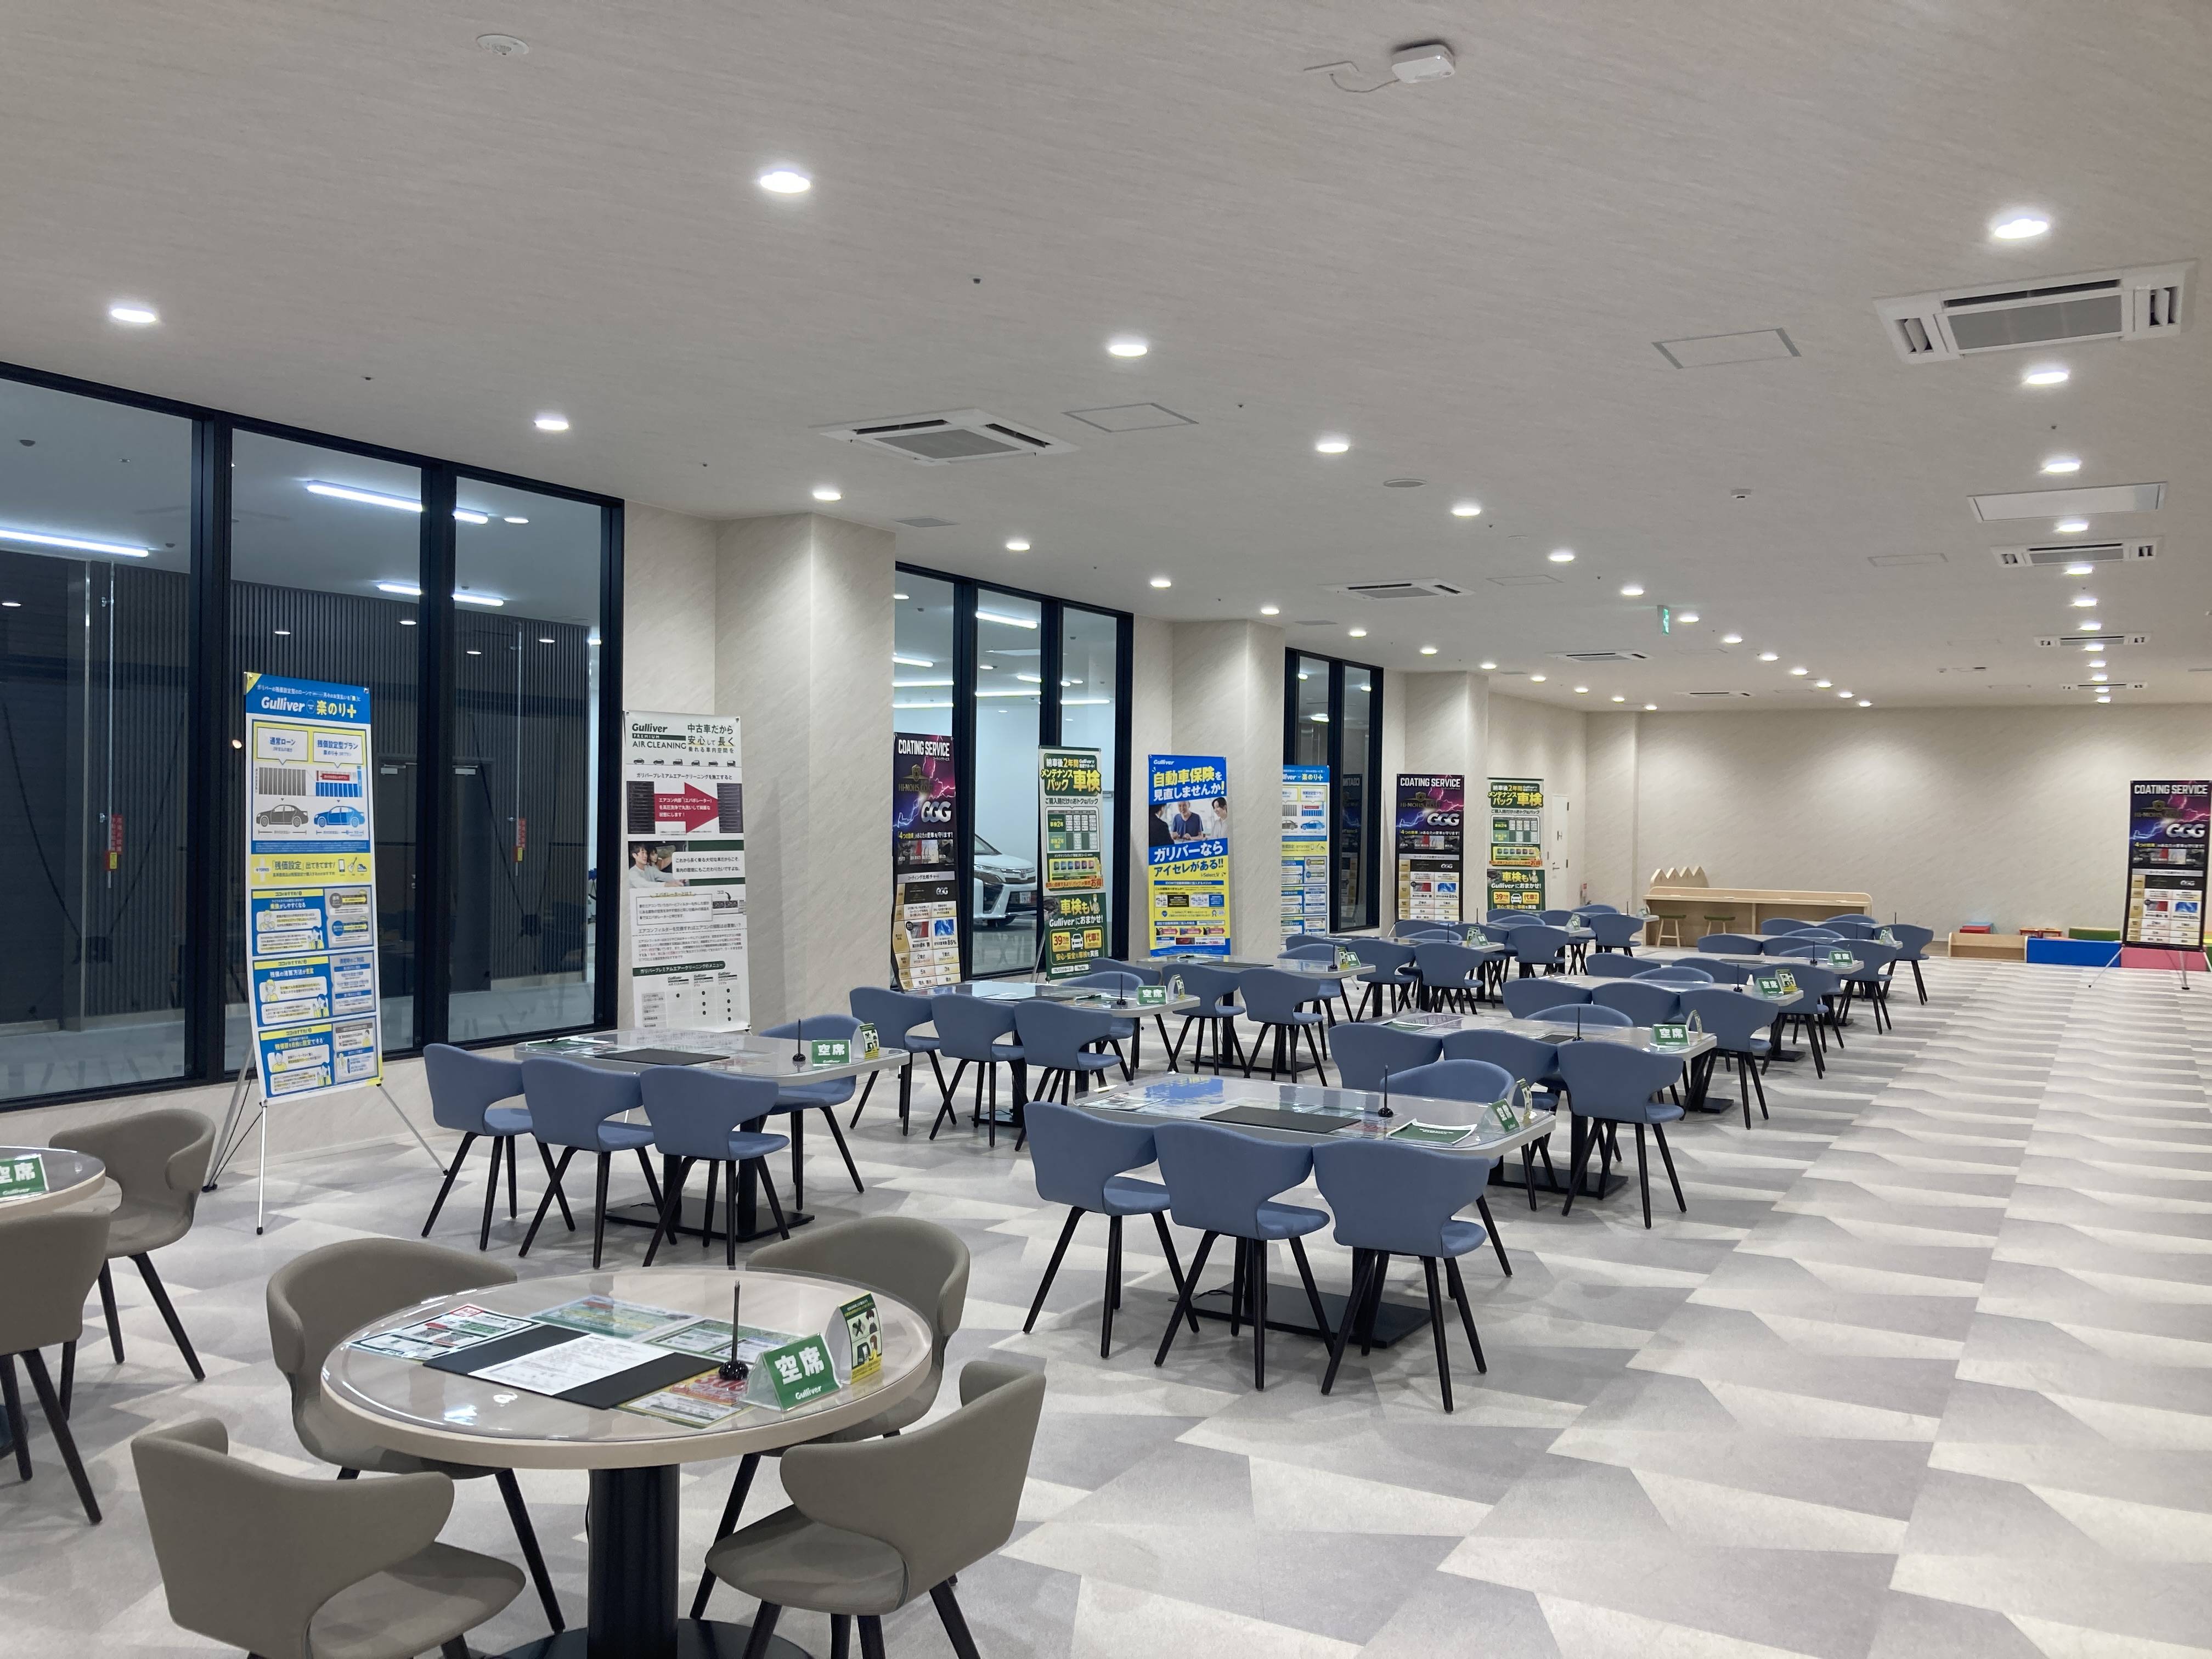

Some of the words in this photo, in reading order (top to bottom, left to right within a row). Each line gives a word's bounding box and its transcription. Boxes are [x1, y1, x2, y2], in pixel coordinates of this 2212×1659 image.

[261, 696, 305, 713] Gulliver
[632, 723, 668, 733] Gulliver
[687, 723, 733, 735] 中古車だから
[647, 741, 687, 750] CLEANING
[688, 735, 735, 747] 安心して長く
[689, 746, 735, 754] 乗れる車内空間を
[898, 739, 924, 755] COATING
[924, 741, 950, 757] SERVICE
[1046, 758, 1079, 768] 納車後2年間
[1041, 769, 1073, 778] メンテナンス
[1154, 766, 1222, 788] 自動車保険を
[1047, 778, 1069, 792] パック
[1073, 769, 1101, 793] 車検
[1400, 777, 1430, 787] COATING
[1431, 778, 1460, 787] SERVICE
[1153, 781, 1224, 802] 見直しませんか!
[2134, 785, 2170, 794] COATING
[2171, 785, 2209, 794] SERVICE
[1493, 797, 1513, 805] パック
[1517, 792, 1543, 806] 車検
[1154, 840, 1223, 863] ガリバーなら
[1154, 858, 1224, 877] アイセレがある!!
[1502, 871, 1529, 882] 車検も
[1060, 898, 1090, 916] 車検も
[1049, 918, 1075, 927] Gulliver
[1075, 915, 1103, 926] におまかせ!
[1142, 989, 1163, 998] 空席
[1659, 1028, 1683, 1039] 空席
[817, 1043, 845, 1056] 空席
[774, 1346, 825, 1385] 空席
[795, 1385, 822, 1400] Gulliver
